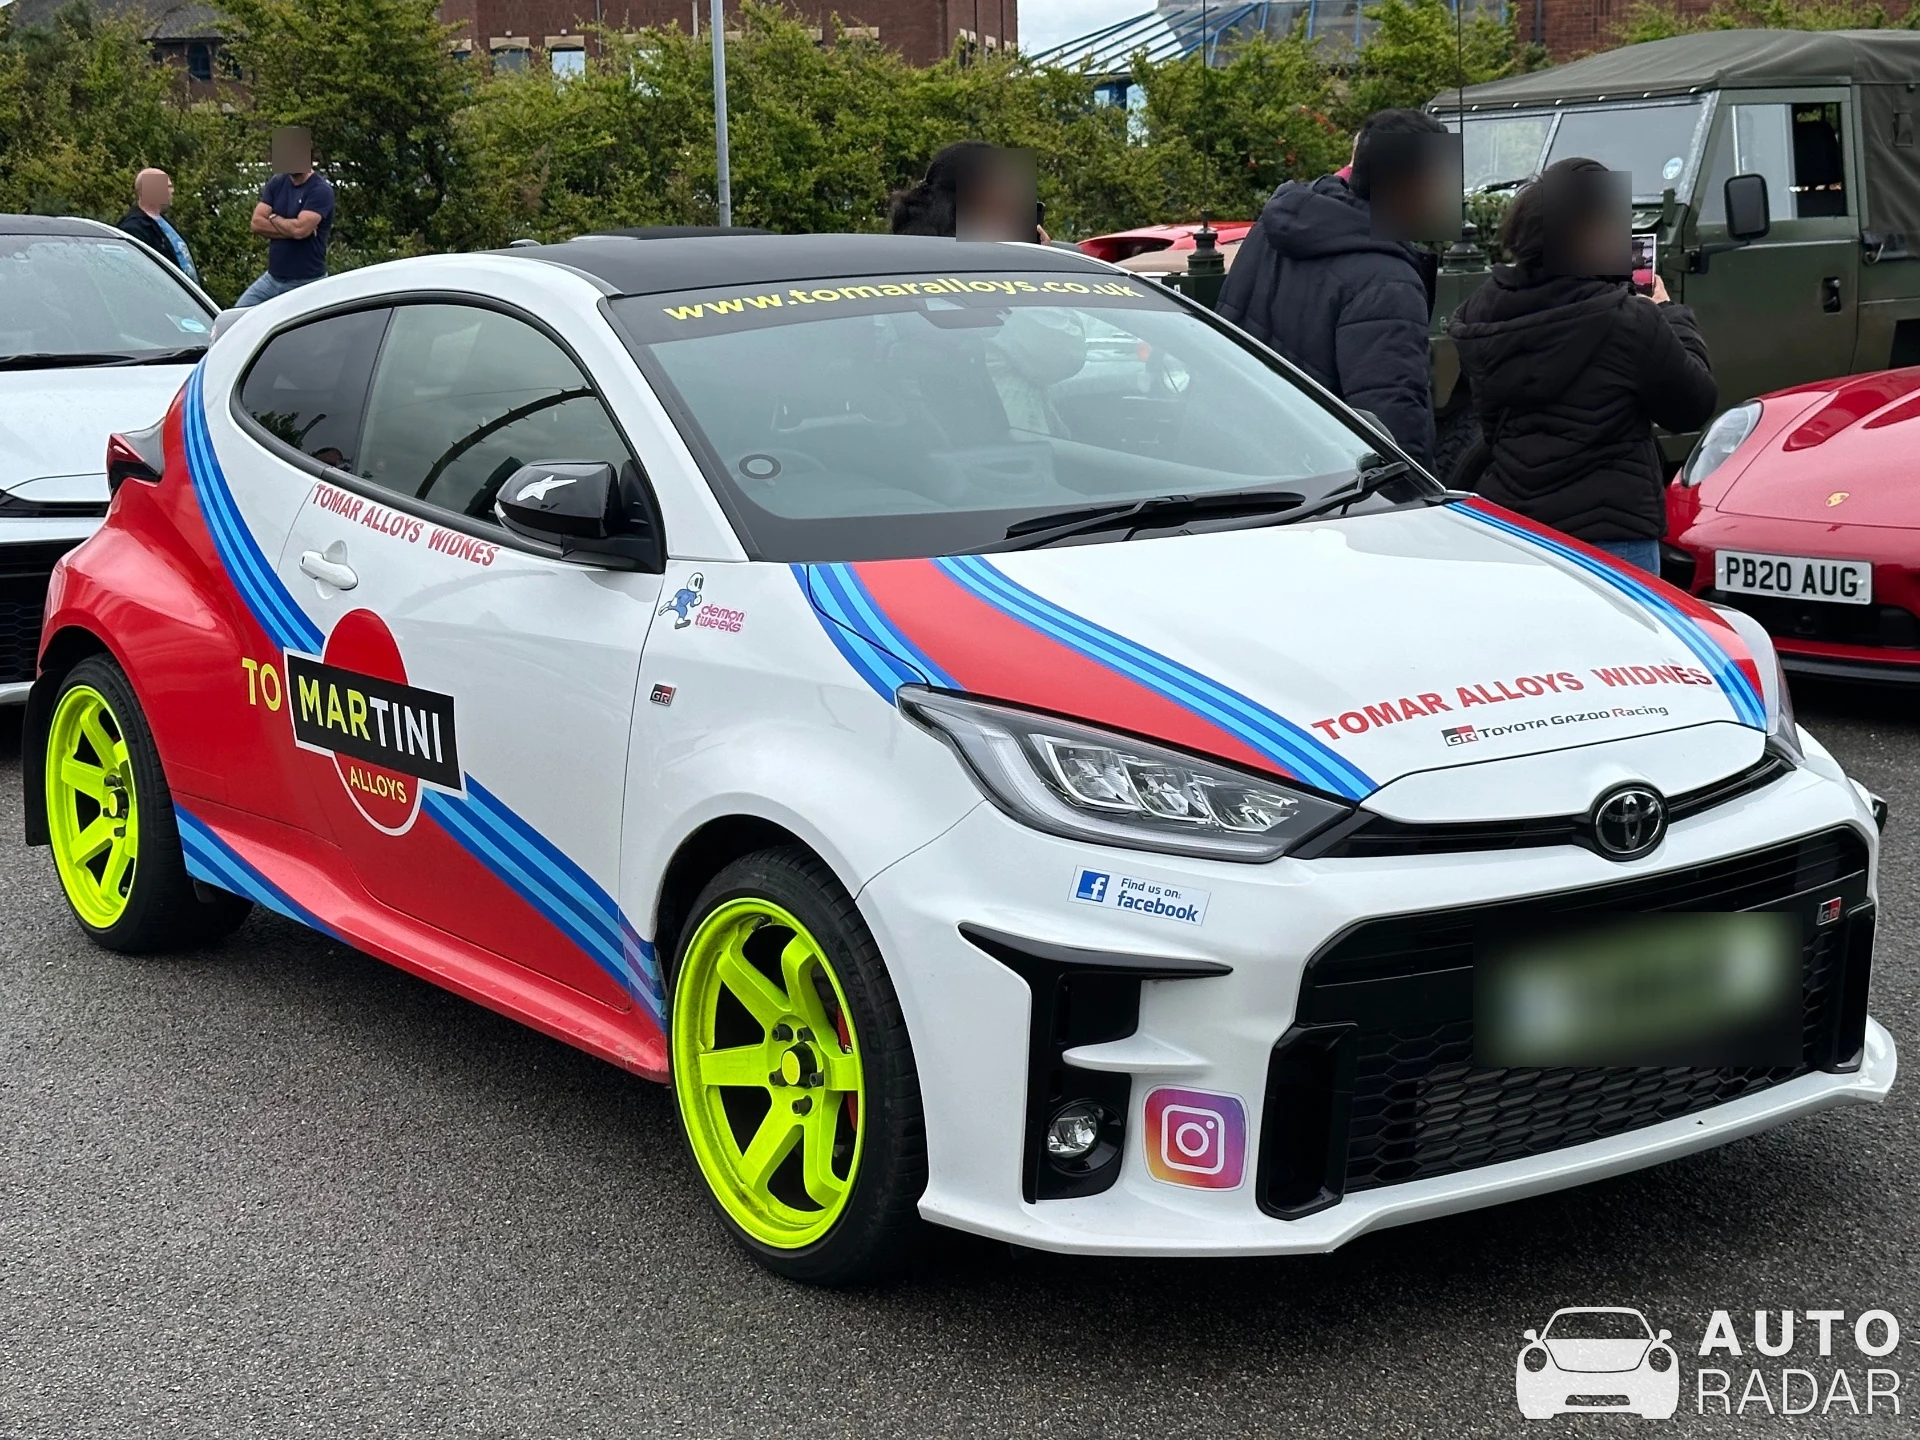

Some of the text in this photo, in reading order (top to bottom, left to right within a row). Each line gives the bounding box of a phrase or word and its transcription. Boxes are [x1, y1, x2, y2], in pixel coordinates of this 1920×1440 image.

[663, 279, 1146, 320] www.tomaralloys.co.uk
[312, 484, 500, 566] TOMAR ALLOYS WIDNES
[1726, 556, 1858, 597] PB20 AUG
[695, 614, 741, 633] tweeks
[701, 604, 745, 622] demon
[241, 657, 443, 763] TO MARTINI
[1310, 665, 1713, 741] TOMAR ALLOYS WIDNES
[1478, 719, 1548, 738] TOYOTA
[1550, 710, 1610, 725] GAZOO
[1611, 705, 1669, 718] Racing
[350, 765, 407, 804] ALLOYS
[1120, 877, 1146, 892] Find
[1148, 885, 1161, 895] us
[1117, 890, 1199, 922] facebook
